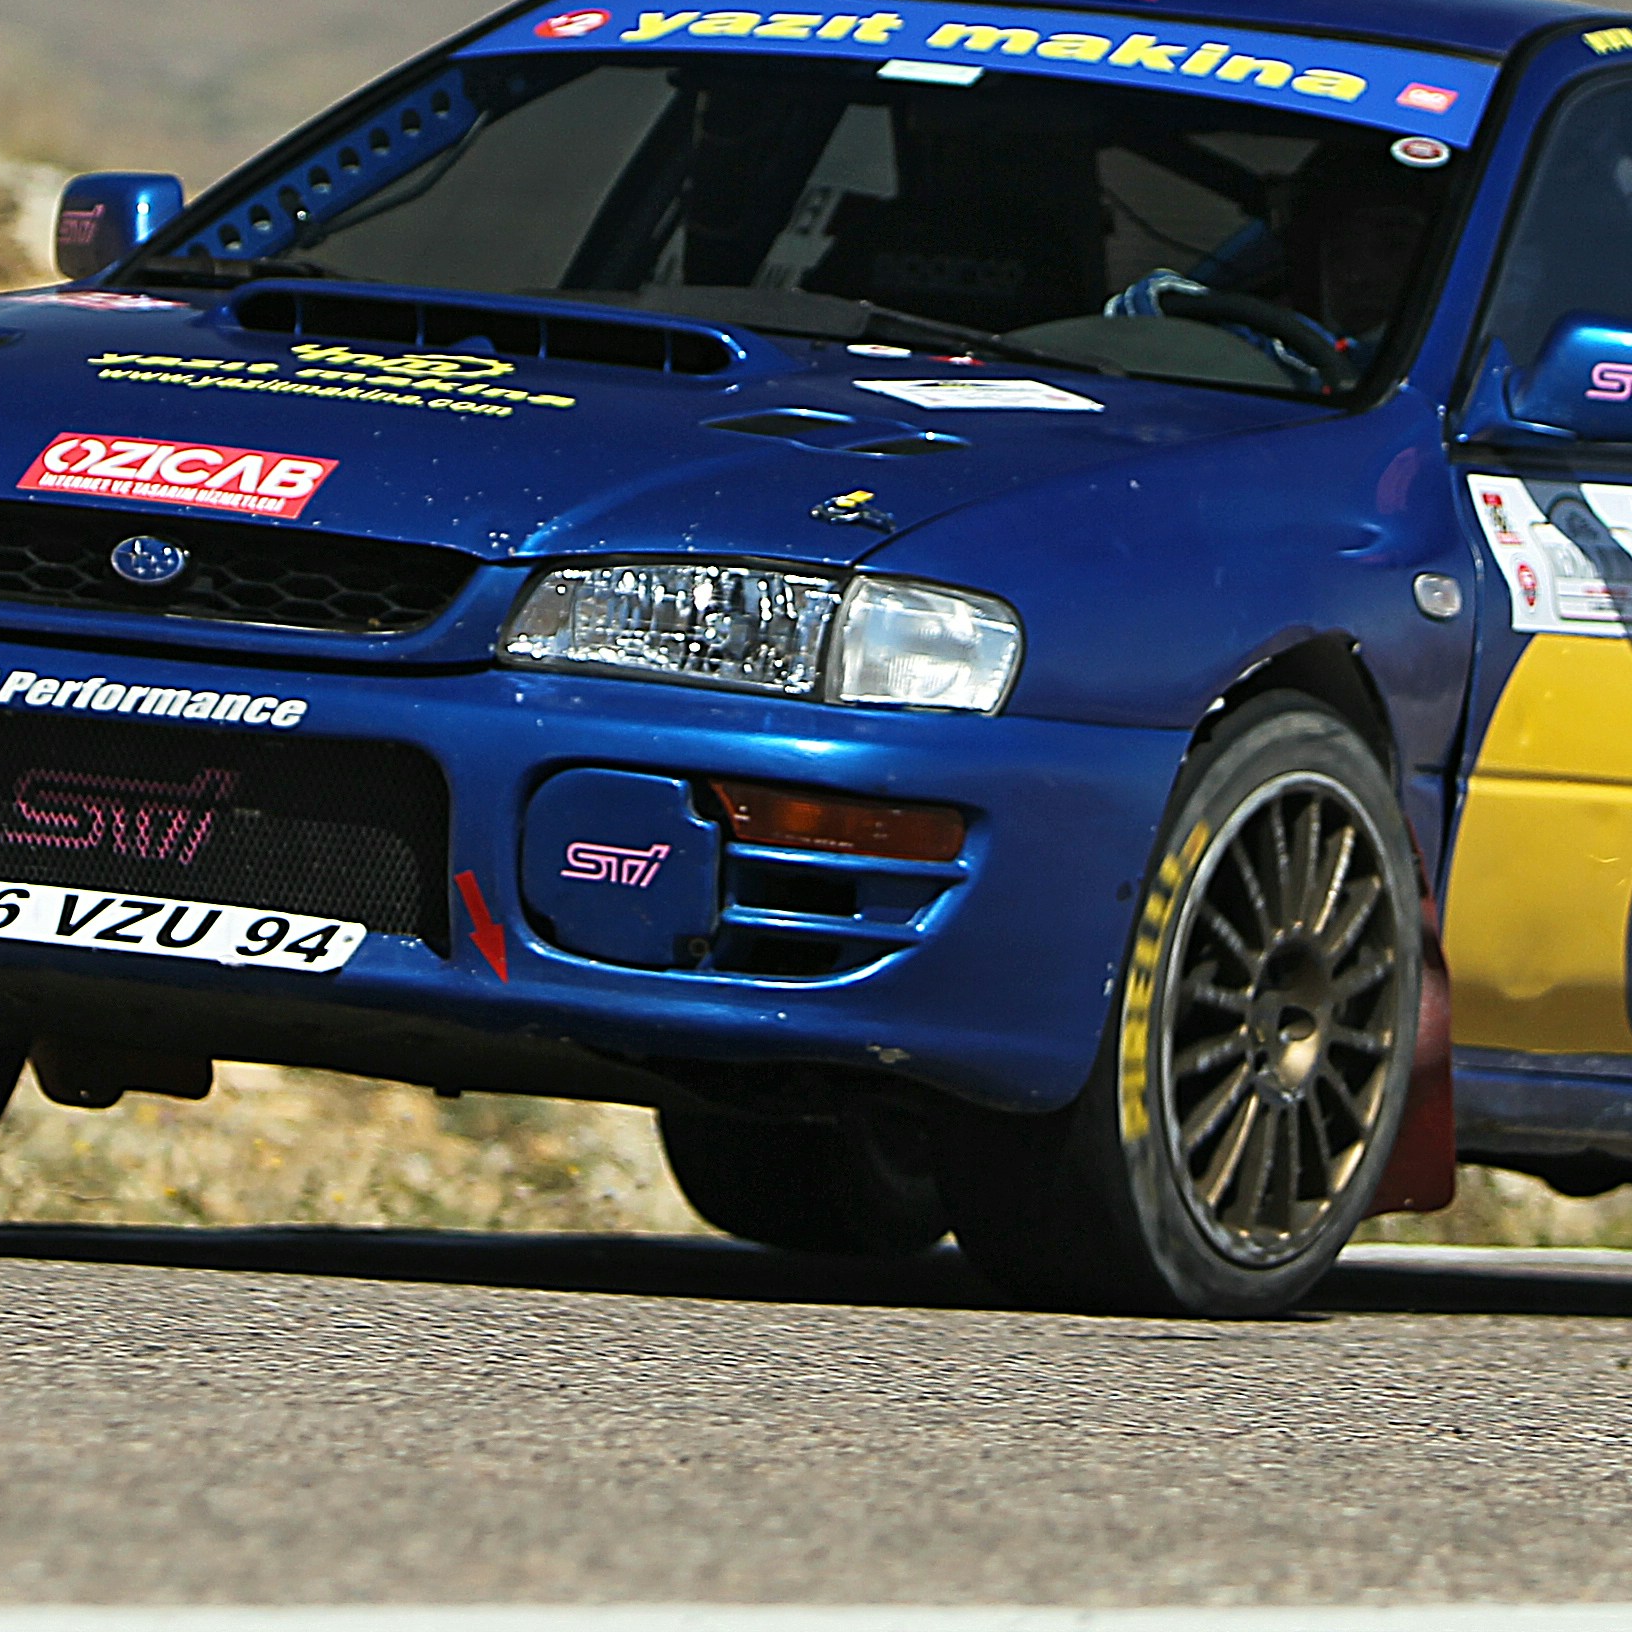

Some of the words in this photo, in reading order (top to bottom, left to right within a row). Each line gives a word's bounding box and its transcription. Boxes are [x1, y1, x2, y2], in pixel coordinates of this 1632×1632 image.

[926, 23, 1367, 103] makina
[55, 893, 223, 949] VZU
[236, 915, 341, 964] 94
